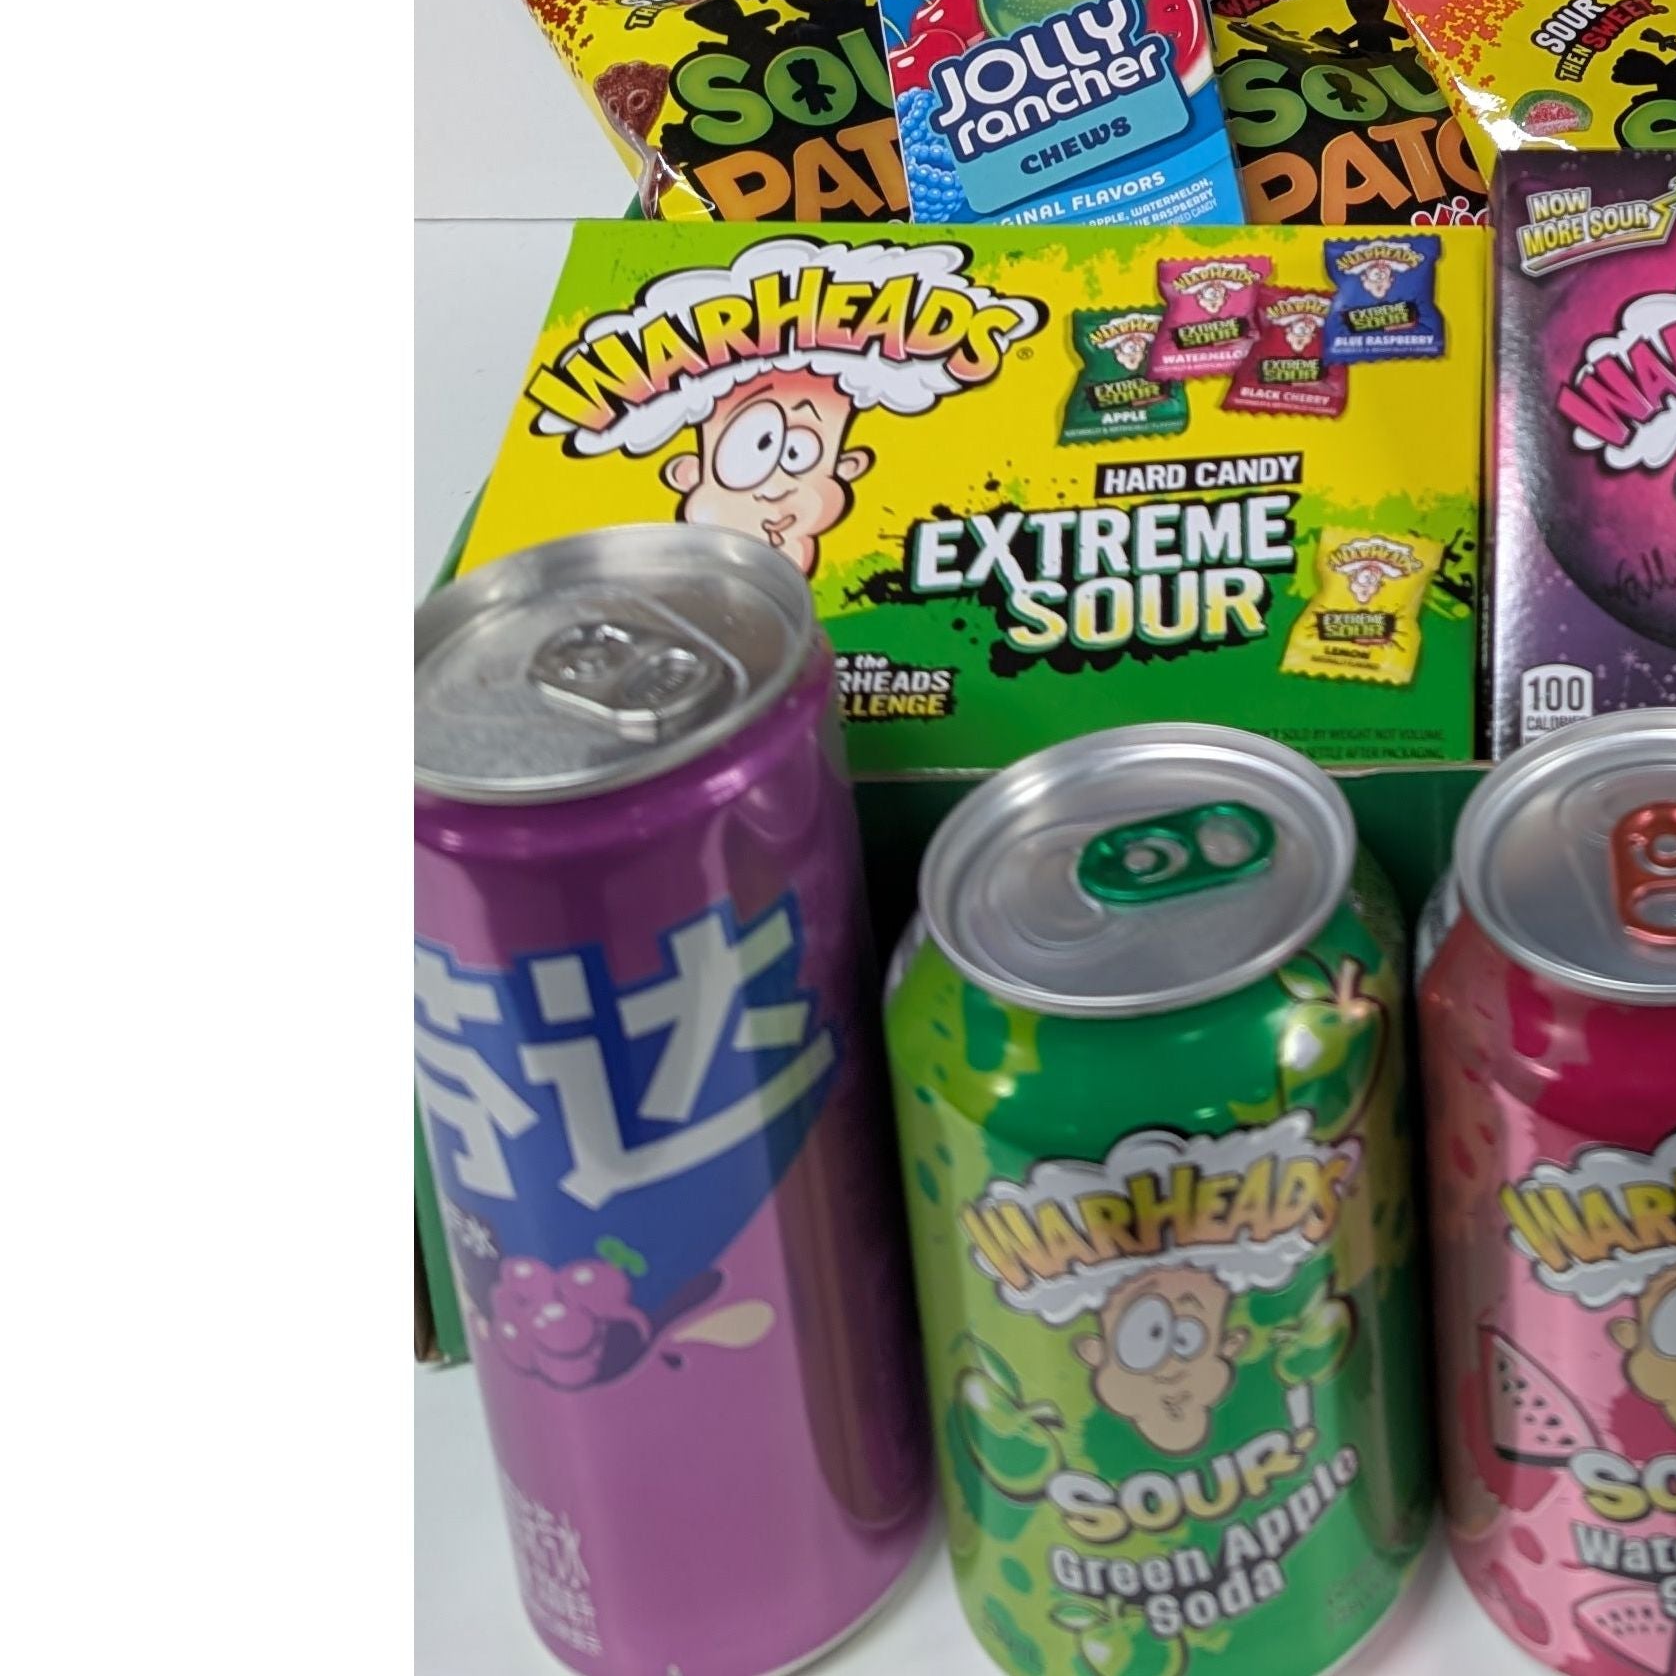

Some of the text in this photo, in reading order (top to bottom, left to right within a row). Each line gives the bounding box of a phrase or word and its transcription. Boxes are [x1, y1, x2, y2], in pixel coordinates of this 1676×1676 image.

[677, 28, 895, 146] SOU
[935, 0, 1128, 128] JOLLY
[1557, 40, 1594, 84] THEN
[956, 44, 1159, 159] rancher
[1219, 57, 1448, 148] SOU
[695, 115, 911, 222] PAT
[1019, 116, 1132, 178] CHEWS
[1242, 115, 1488, 225] PATC
[993, 171, 1167, 226] GINAL FLAVORS
[1151, 188, 1214, 222] RASPBERRY
[1191, 198, 1219, 221] CANDY
[1532, 190, 1590, 221] NOW
[1521, 202, 1652, 256] MORE SOUR
[527, 265, 1013, 436] WARHEADS
[1162, 349, 1246, 365] WATERMELO
[1334, 334, 1435, 347] BLUE RASPBERRY
[1102, 410, 1148, 425] APPLE
[1239, 386, 1281, 401] BLACK
[1284, 389, 1330, 406] CHERRY
[1104, 454, 1299, 495] HARD CANDY
[913, 500, 1295, 590] EXTREME
[1005, 567, 1268, 652] SOUR
[836, 670, 951, 694] RHEADS
[854, 654, 889, 670] the
[837, 693, 948, 718] LLENGE
[1527, 676, 1585, 712] 100
[961, 1154, 1355, 1293] WARHEADS
[1046, 1384, 1318, 1545] SOUR!
[1050, 1444, 1361, 1598] Green Apple
[1146, 1558, 1286, 1639] Soda
